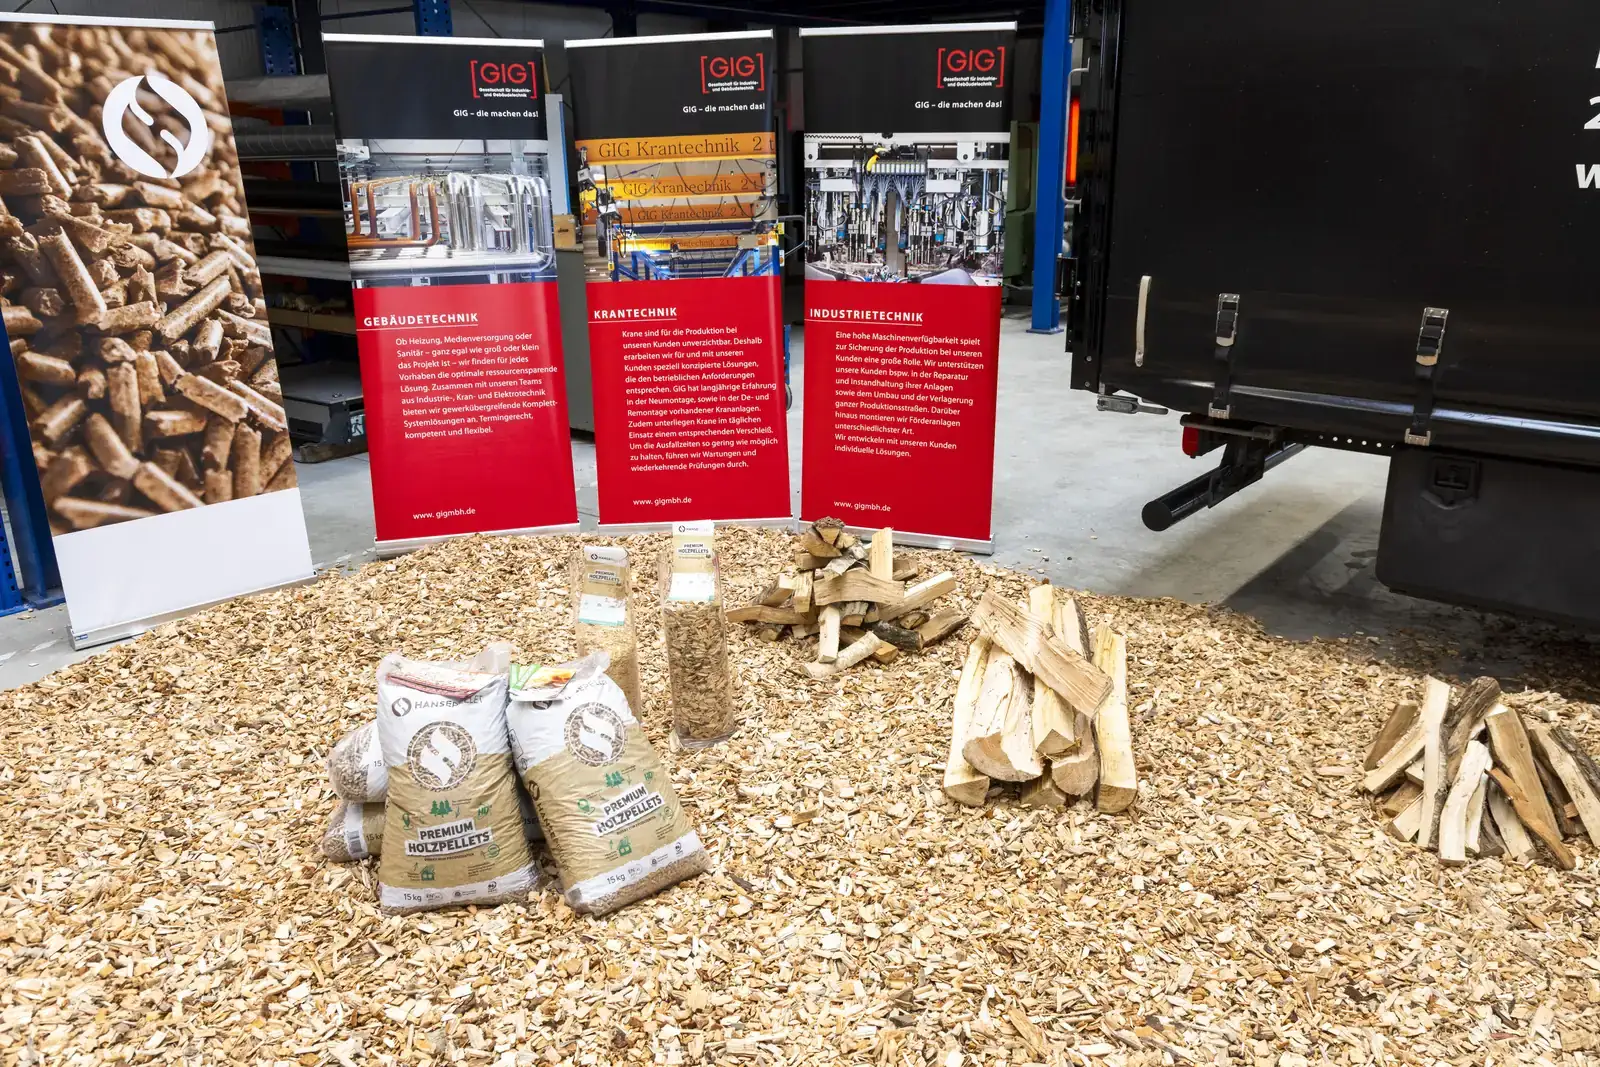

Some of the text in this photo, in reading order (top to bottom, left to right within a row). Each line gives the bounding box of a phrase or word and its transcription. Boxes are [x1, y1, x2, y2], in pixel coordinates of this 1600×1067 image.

[710, 56, 755, 78] GIG
[947, 49, 995, 72] GIG
[480, 62, 527, 84] GIG
[599, 142, 630, 157] GIG
[637, 138, 740, 157] Krantechnik
[752, 136, 762, 151] 2
[653, 180, 732, 194] Krantechnik
[741, 179, 748, 190] 2
[364, 312, 478, 326] GEBÄUDETECHNIK
[594, 307, 677, 318] KRANTECHNIK
[810, 308, 923, 322] INDUSTRIETECHNIK
[395, 337, 407, 345] Ob
[409, 337, 442, 345] Heizung,
[444, 334, 514, 343] Medienversorgung
[682, 338, 732, 346] unverzichtbar.
[852, 331, 870, 339] hohe
[872, 332, 958, 344] Maschinenverfügbarkeit
[960, 337, 980, 346] spielt
[396, 349, 423, 357] Sanitär
[432, 349, 450, 357] ganz
[451, 346, 468, 356] egal
[484, 344, 501, 354] groß
[848, 342, 884, 353] Sicherung
[898, 345, 938, 354] Produktion
[413, 360, 439, 369] Projekt
[509, 355, 528, 364] jedes
[653, 362, 680, 371] speziell
[681, 361, 721, 370] konzipierte
[836, 354, 862, 362] Kunden
[880, 356, 902, 365] große
[903, 357, 922, 366] Rolle.
[938, 361, 984, 369] unterstützen
[398, 372, 436, 380] Vorhaben
[451, 369, 484, 378] optimale
[486, 365, 558, 376] ressourcensparende
[653, 373, 700, 381] betrieblichen
[702, 372, 755, 380] Anforderungen
[860, 367, 887, 375] Kunden
[889, 368, 909, 377] bspw.
[919, 370, 932, 378] der
[933, 371, 968, 380] Reparatur
[626, 386, 671, 395] entsprechen.
[701, 383, 740, 392] langjährige
[742, 382, 776, 390] Erfahrung
[851, 378, 904, 389] Instandhaltung
[905, 381, 922, 389] ihrer
[923, 382, 953, 392] Anlagen
[416, 394, 455, 403] Industrie-,
[493, 388, 546, 398] Elektrotechnik
[604, 786, 647, 815] PREMIUM
[596, 795, 663, 832] HOLZPELLETS
[420, 821, 474, 840] PREMIUM
[408, 832, 490, 852] HOLZPELLETS
[615, 873, 625, 882] kg
[415, 894, 421, 902] kg
